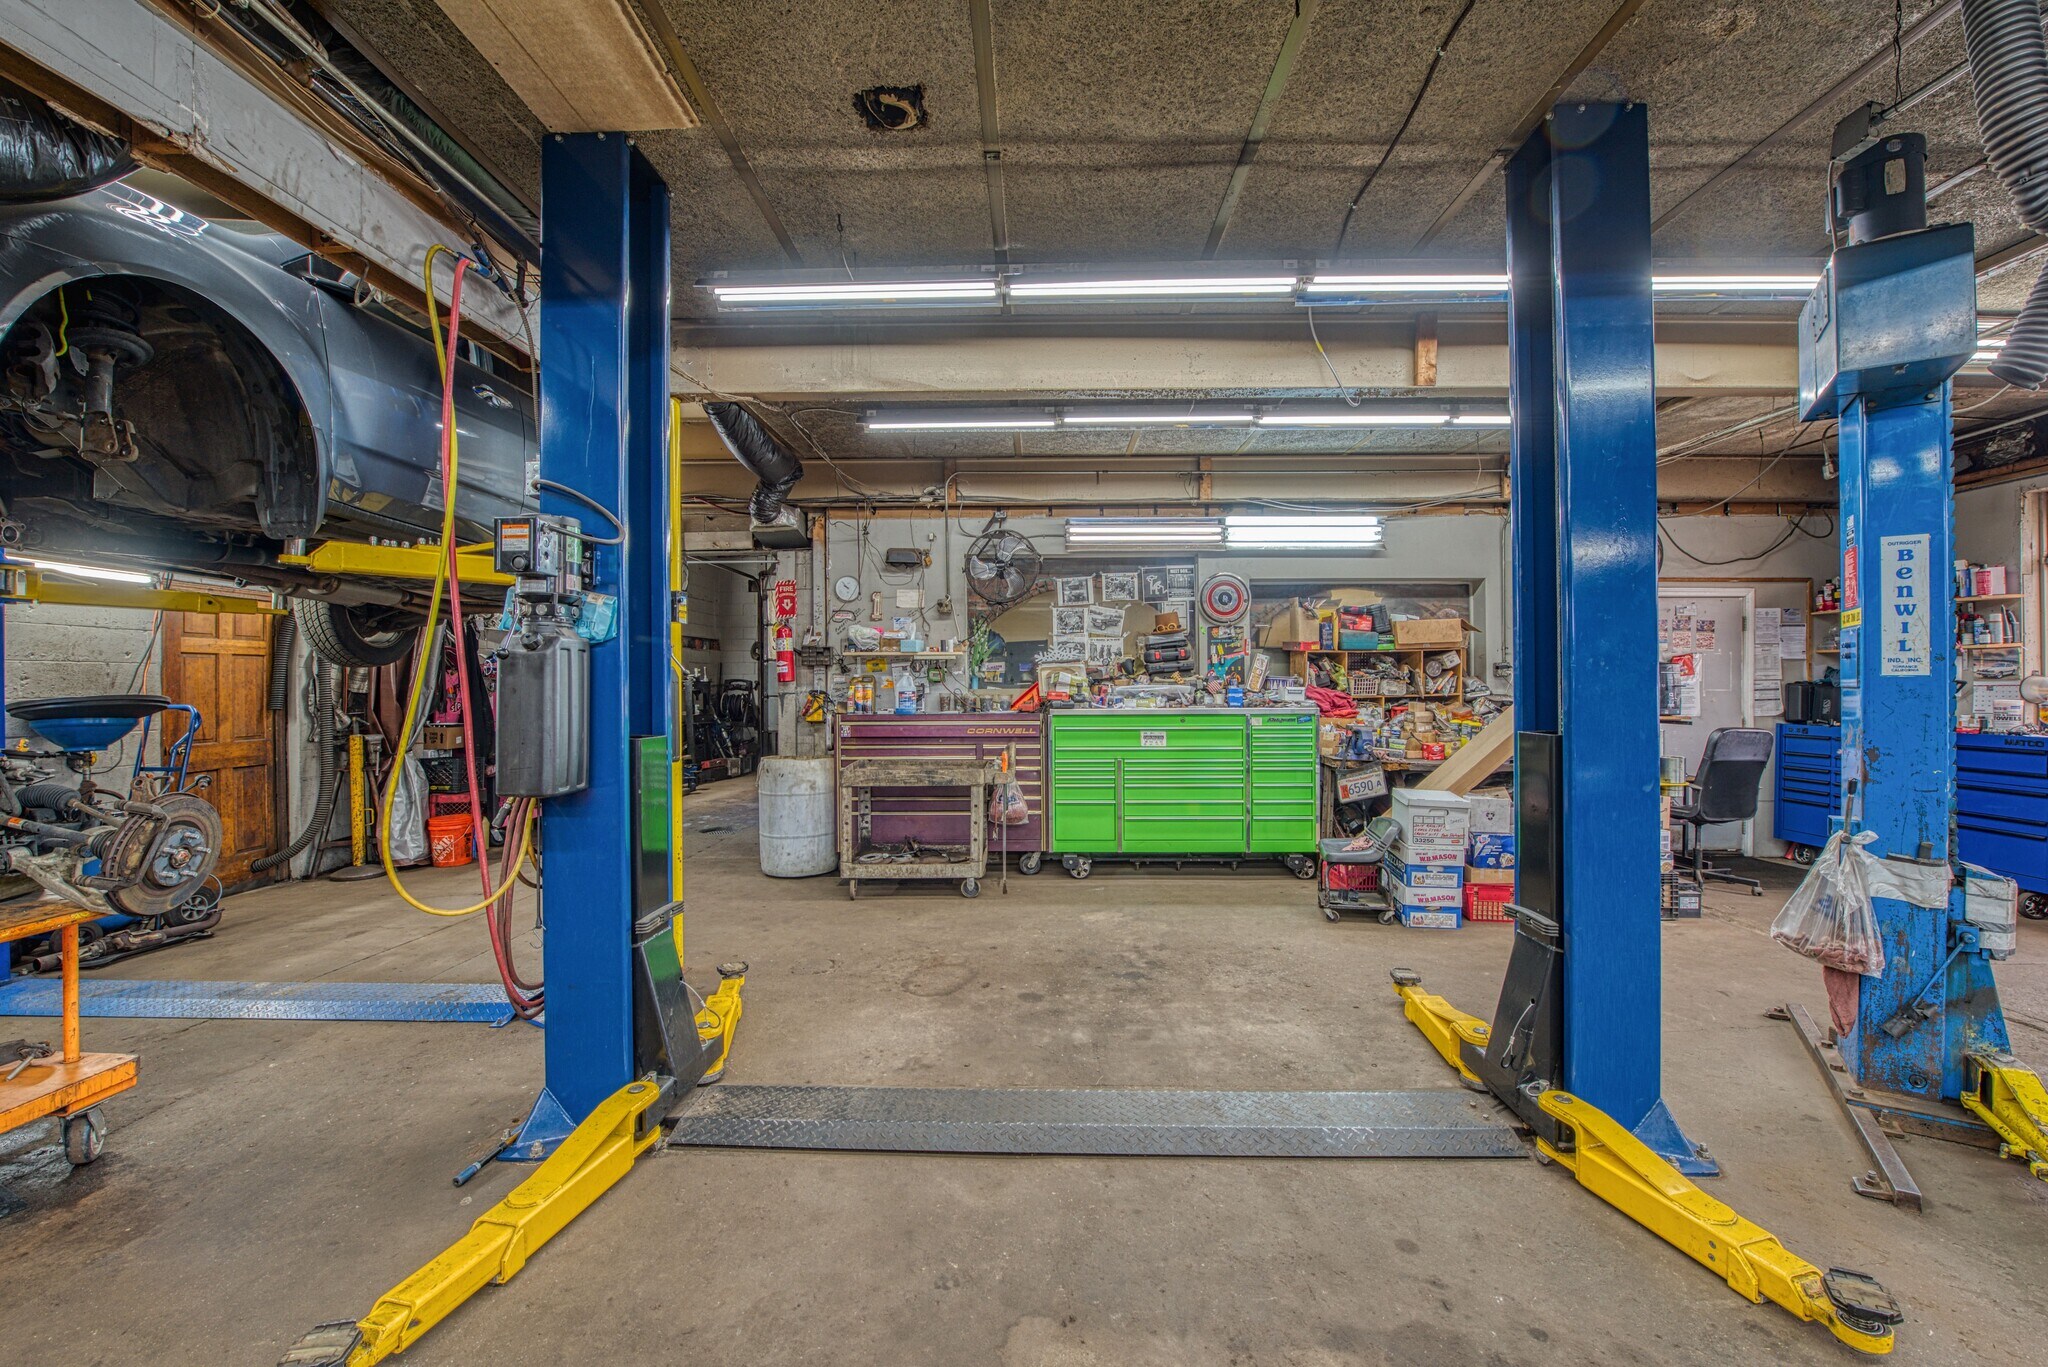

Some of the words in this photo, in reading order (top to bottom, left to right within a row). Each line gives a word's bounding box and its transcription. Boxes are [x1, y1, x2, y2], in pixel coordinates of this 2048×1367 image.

[966, 727, 1037, 735] CORNWELL
[2004, 738, 2045, 748] MATCO
[1349, 779, 1374, 796] 6590
